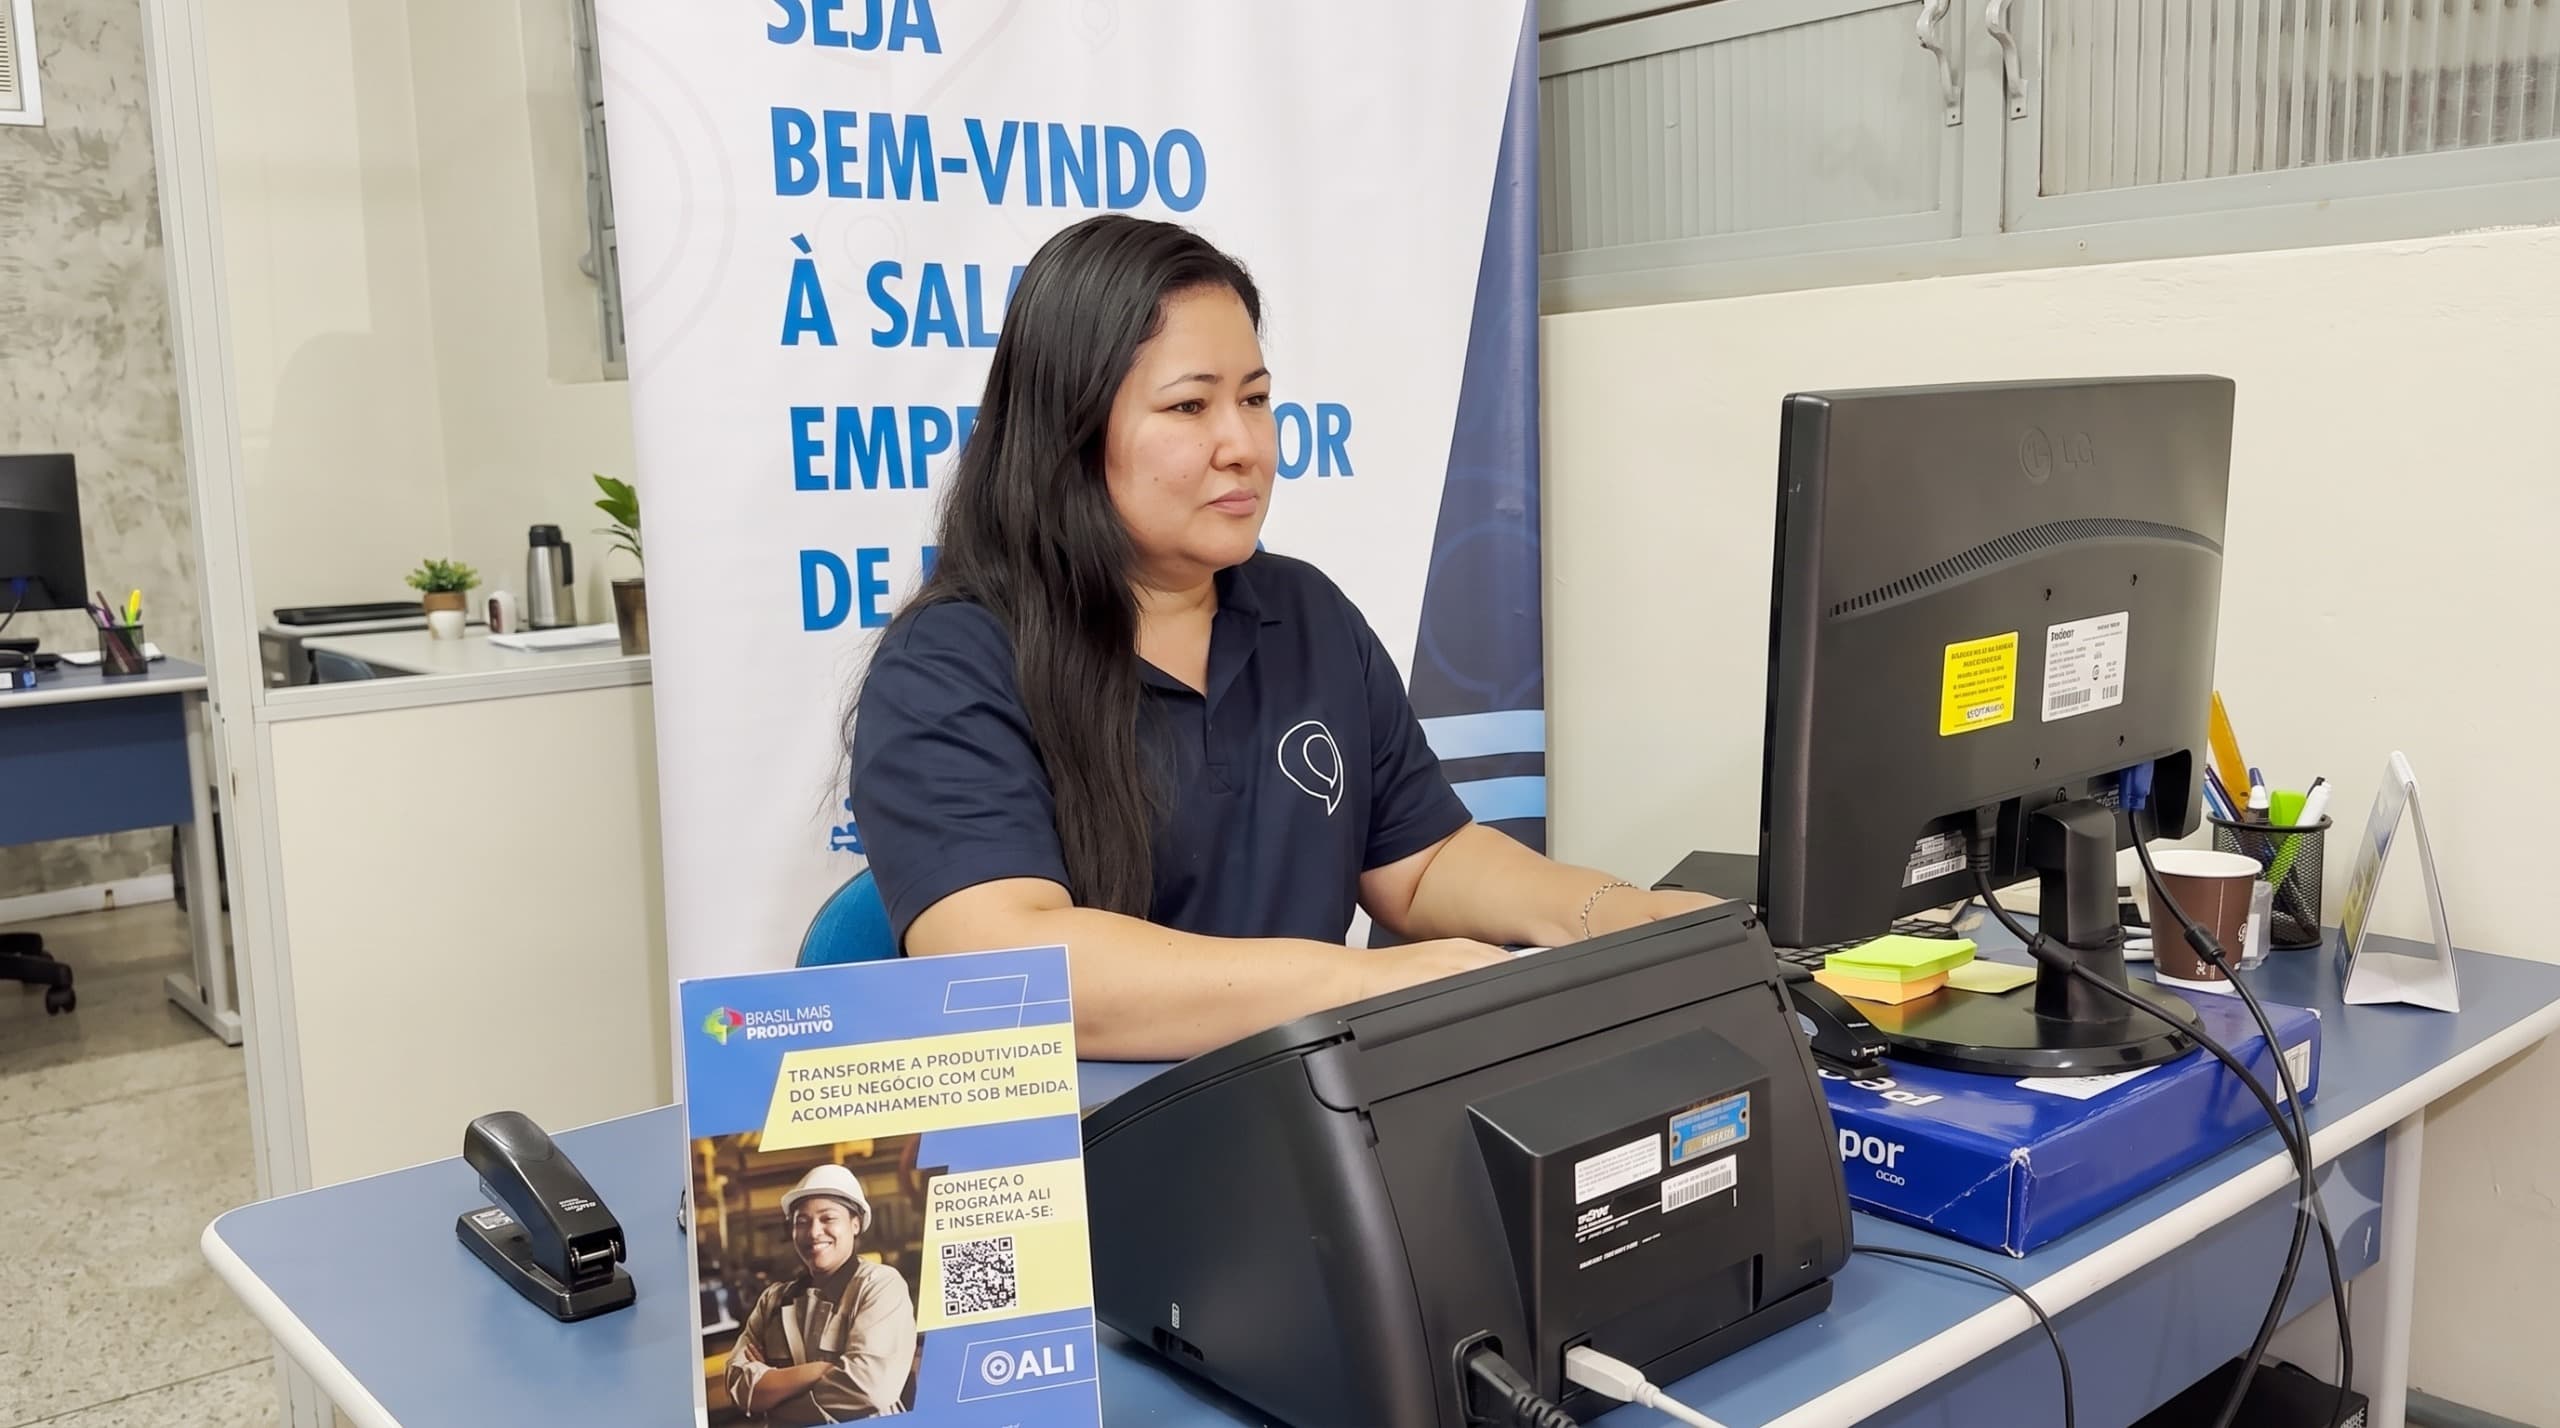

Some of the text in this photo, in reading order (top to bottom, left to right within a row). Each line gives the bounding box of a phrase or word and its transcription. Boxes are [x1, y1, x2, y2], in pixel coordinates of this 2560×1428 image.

[770, 106, 1206, 212] BEM-VINDO
[780, 234, 838, 347] À
[799, 547, 892, 632] DE
[745, 1004, 832, 1026] BRASIL MAIS
[746, 1019, 834, 1040] PRODUTIVO
[787, 1041, 1063, 1083] TRANSFORME A PRODUTIVIDADE
[789, 1066, 1016, 1103] DO SEU NEGÓCIO COM CUM
[791, 1079, 1074, 1123] ACOMPANHAMENTO SOB MEDIDA.
[933, 1174, 1025, 1196] CONHEÇA O
[935, 1187, 1051, 1213] PROGRAMA ALI
[936, 1219, 945, 1231] E
[1016, 1343, 1076, 1380] ALI
